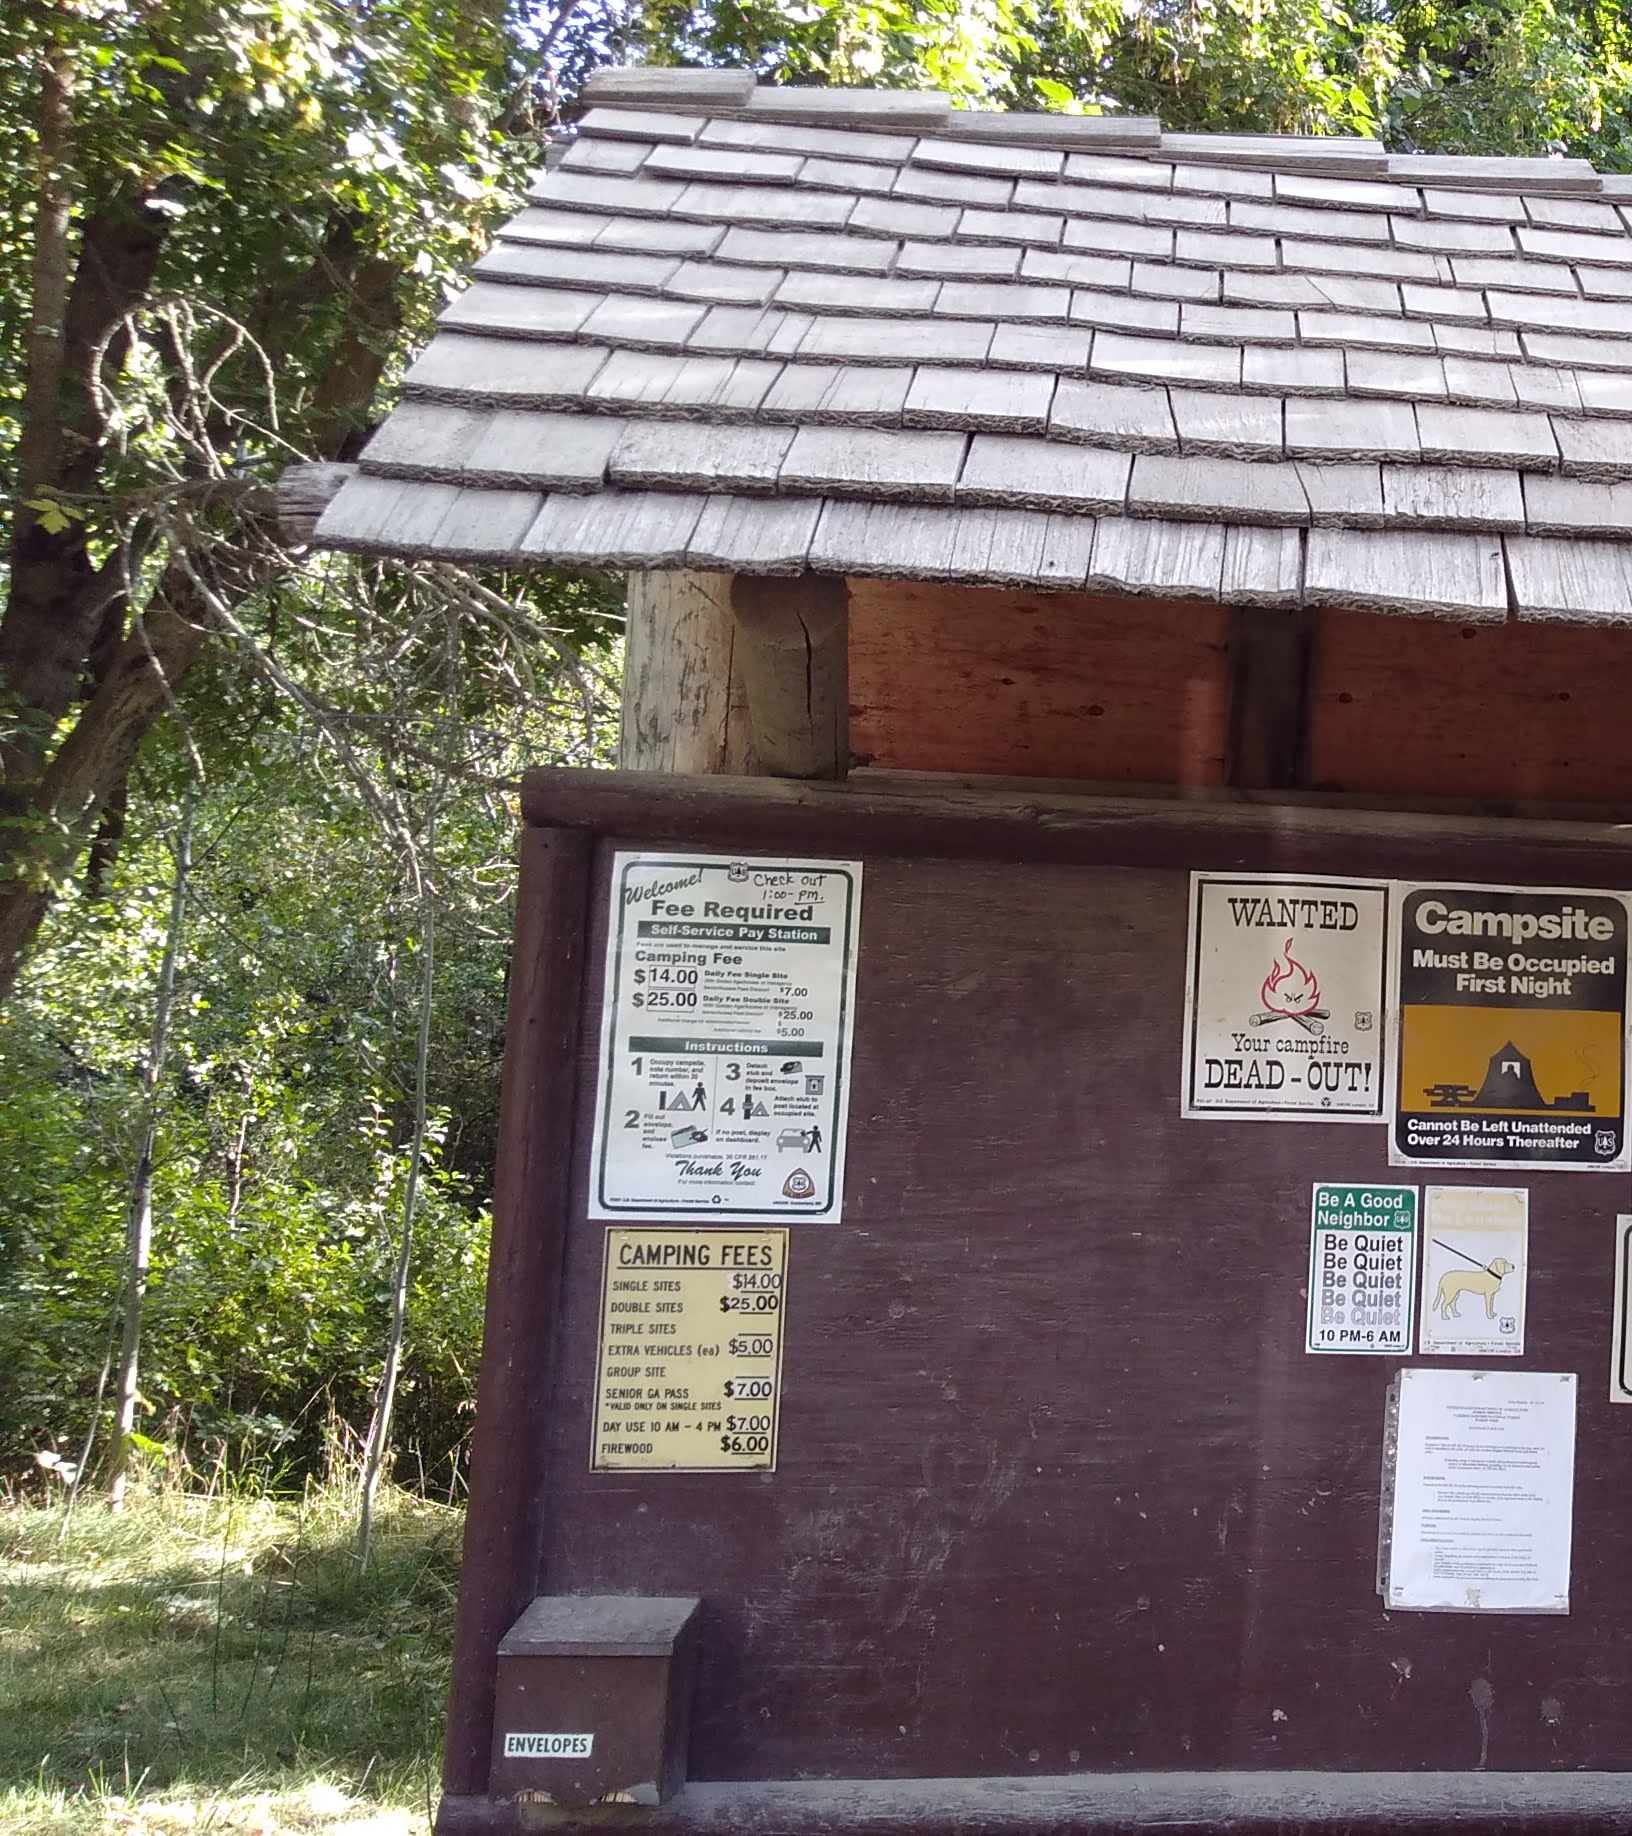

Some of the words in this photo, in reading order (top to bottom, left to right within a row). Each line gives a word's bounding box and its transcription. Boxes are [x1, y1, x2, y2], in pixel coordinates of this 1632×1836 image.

[625, 867, 705, 905] Welcome!
[753, 869, 795, 887] Check
[801, 874, 827, 887] out
[651, 900, 695, 917] Fee
[704, 901, 813, 922] Required
[1228, 898, 1358, 930] WANTED
[1415, 900, 1615, 945] Campsite
[651, 924, 733, 937] Self-Service
[739, 928, 762, 942] Pay
[764, 928, 818, 941] Station
[635, 950, 707, 966] Camping
[713, 953, 743, 964] Fee
[1412, 949, 1468, 968] Must
[1473, 951, 1504, 971] Be
[1507, 954, 1615, 976] Occupied
[1456, 974, 1506, 993] First
[1511, 976, 1572, 998] Night
[685, 1041, 768, 1053] Instructions
[1231, 1033, 1271, 1053] Your
[1276, 1035, 1349, 1059] campfire
[1307, 1060, 1372, 1092] OUT!
[1407, 1118, 1458, 1132] Cannot
[1460, 1120, 1480, 1131] Be
[1482, 1121, 1509, 1133] Left
[1511, 1121, 1592, 1135] Unattended
[1407, 1133, 1440, 1146] Over
[1443, 1134, 1460, 1146] 24
[1463, 1135, 1504, 1147] Hours
[1507, 1135, 1579, 1149] Thereafter
[675, 1160, 724, 1177] Thank
[729, 1161, 763, 1181] You
[1318, 1192, 1340, 1207] Be
[1344, 1193, 1355, 1207] A
[1360, 1194, 1403, 1209] Good
[1317, 1210, 1390, 1228] Neighbor
[1325, 1234, 1348, 1250] Be
[1354, 1235, 1403, 1252] Quiet
[620, 1243, 710, 1265] CAMPING
[721, 1245, 772, 1265] FEES
[1323, 1252, 1347, 1270] Be
[1353, 1253, 1403, 1271] Quiet
[612, 1281, 649, 1291] SINGLE
[653, 1281, 681, 1291] SITES
[732, 1273, 781, 1289] $14.00
[1322, 1271, 1346, 1289] Be
[1352, 1272, 1402, 1289] Quiet
[611, 1302, 651, 1312] DOUBLE
[656, 1302, 683, 1312] SITES
[720, 1295, 778, 1312] $25.00
[1321, 1289, 1345, 1307] Be
[1352, 1290, 1402, 1308] Quiet
[1320, 1307, 1345, 1325] Be
[1351, 1308, 1401, 1326] Quiet
[610, 1324, 643, 1334] TRIPLE
[649, 1324, 676, 1334] SITES
[1319, 1330, 1335, 1341] 10
[1379, 1331, 1401, 1342] AM
[608, 1345, 640, 1356] EXTRA
[644, 1345, 692, 1356] VEHICLES
[697, 1345, 720, 1357] (ea)
[729, 1339, 773, 1355] $5.00
[607, 1367, 641, 1377] GROUP
[645, 1367, 666, 1377] SITE
[605, 1388, 643, 1399] SENIOR
[648, 1389, 660, 1399] GA
[665, 1388, 689, 1398] PASS
[724, 1381, 772, 1397] $7.00
[634, 1402, 652, 1410] ONLY
[657, 1402, 667, 1410] ON
[670, 1402, 697, 1410] SINGLE
[701, 1402, 721, 1411] SITES
[603, 1422, 621, 1432] DAY
[626, 1422, 645, 1432] USE
[651, 1422, 661, 1432] 10
[665, 1422, 679, 1432] AM
[695, 1422, 702, 1432] 4
[707, 1422, 721, 1432] PM
[726, 1415, 770, 1431] $7.00
[602, 1443, 653, 1454] FIREWOOD
[720, 1435, 769, 1452] $6.00
[508, 1737, 587, 1753] ENVELOPES
